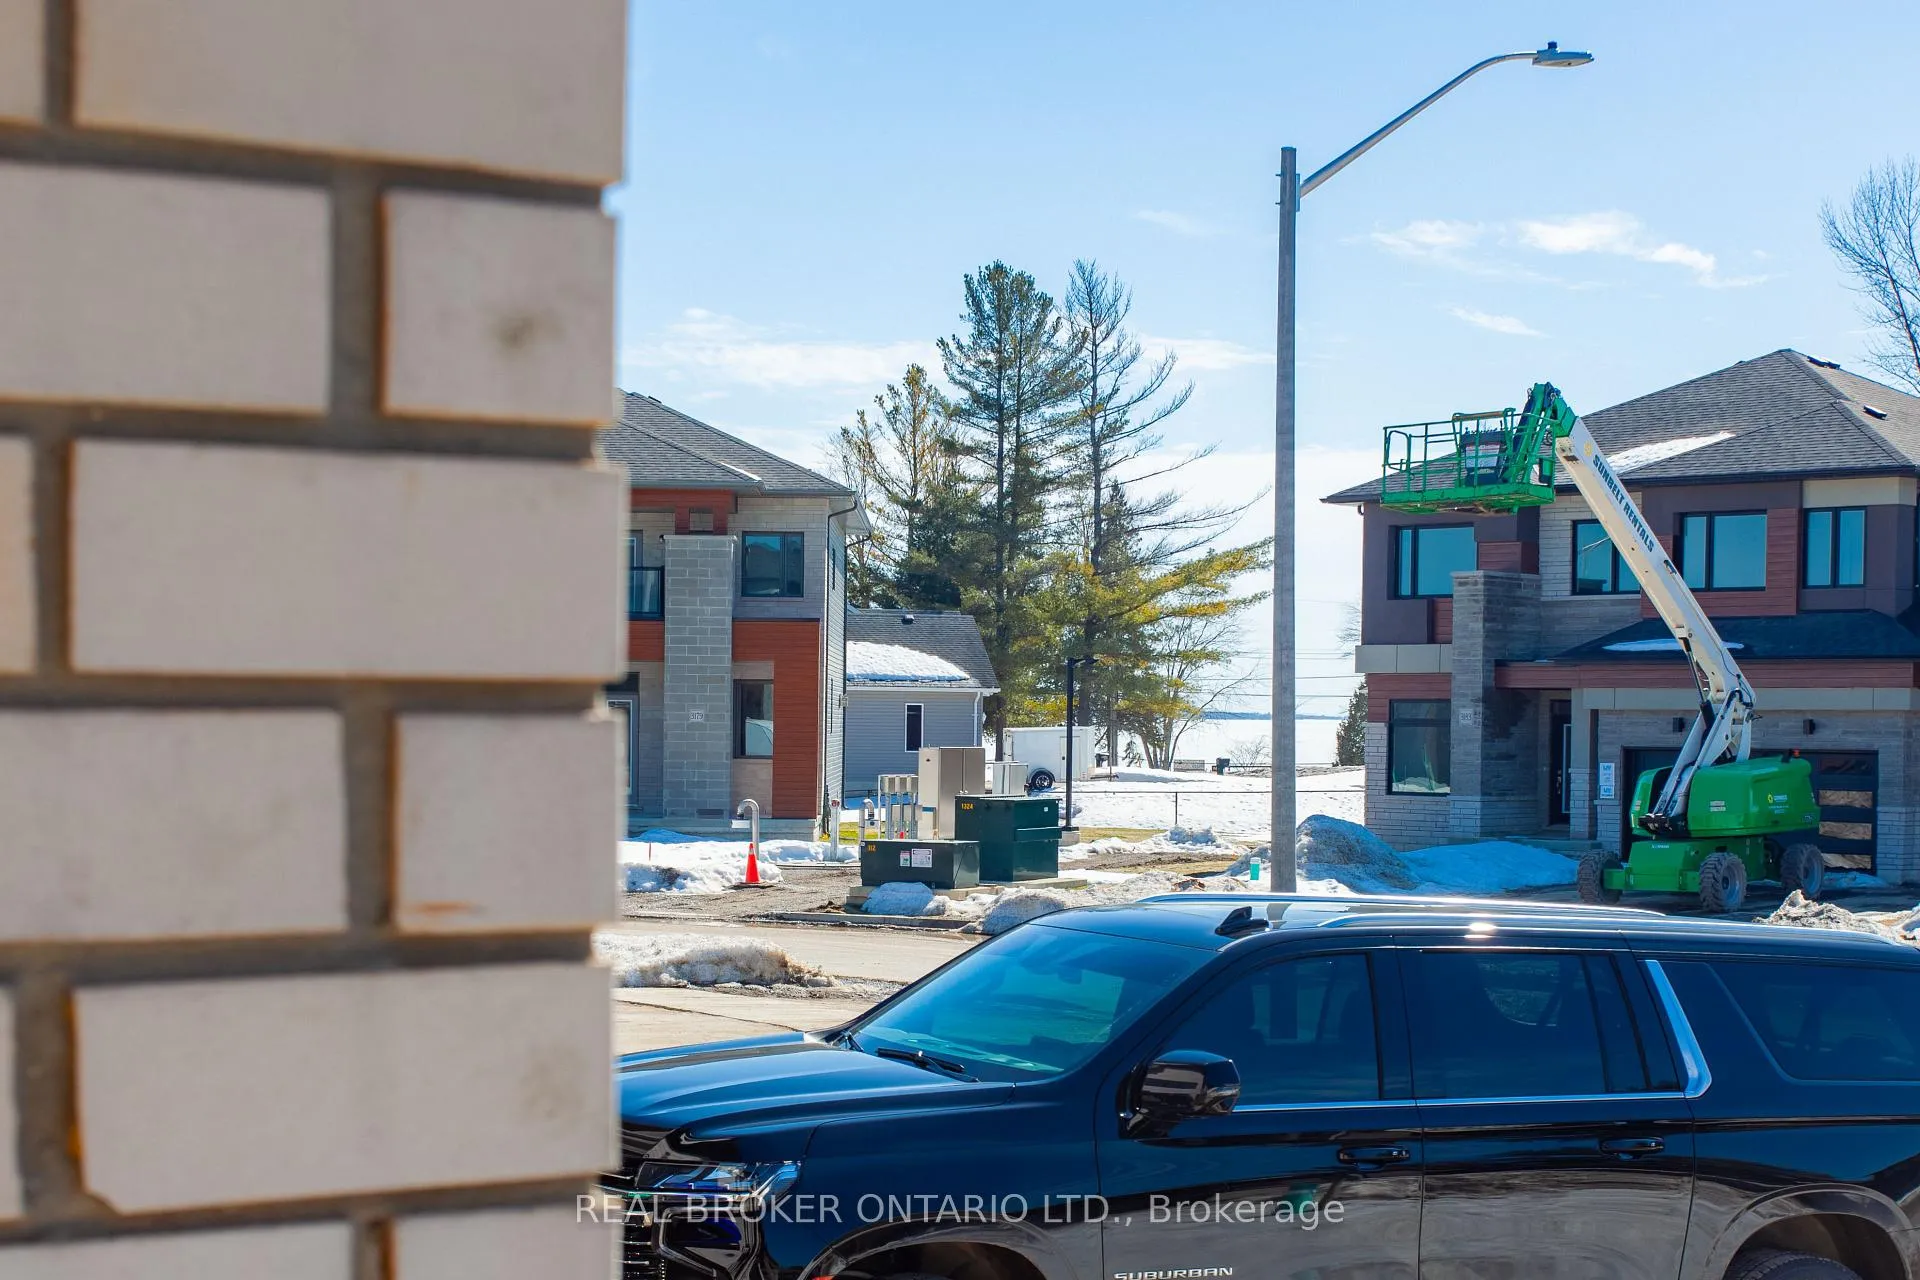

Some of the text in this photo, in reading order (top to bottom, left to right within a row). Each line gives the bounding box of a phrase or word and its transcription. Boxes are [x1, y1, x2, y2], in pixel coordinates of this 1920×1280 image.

[1592, 454, 1654, 552] SUNBELT RENTALS
[1114, 1267, 1233, 1280] SUBURBAN
